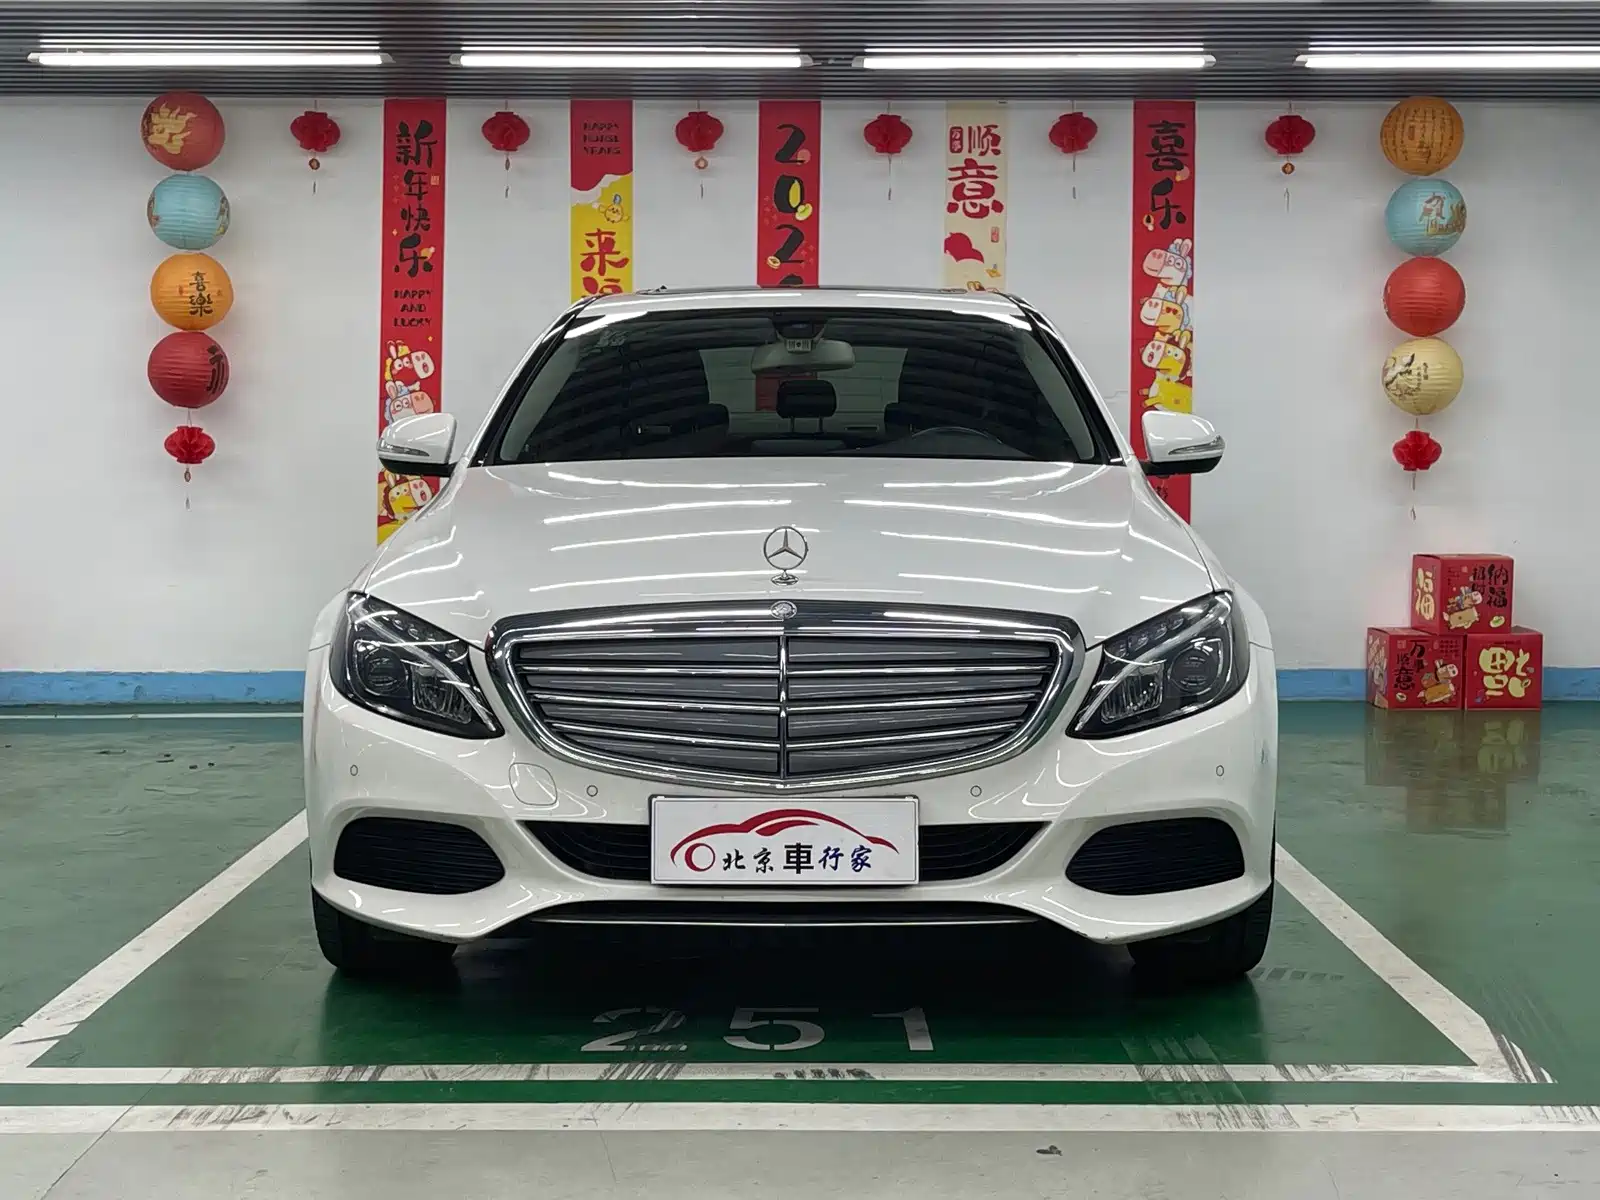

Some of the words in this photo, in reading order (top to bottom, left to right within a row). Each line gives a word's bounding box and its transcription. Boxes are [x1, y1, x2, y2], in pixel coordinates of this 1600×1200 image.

[946, 124, 1004, 219] 顺意
[1145, 119, 1189, 230] 喜乐
[394, 119, 438, 278] 新年快乐
[773, 123, 807, 287] 202
[188, 270, 213, 318] 喜樂
[393, 289, 433, 299] HAPPY
[400, 303, 427, 313] AND
[722, 842, 872, 875] 北京車行家
[580, 1006, 934, 1051] 251
